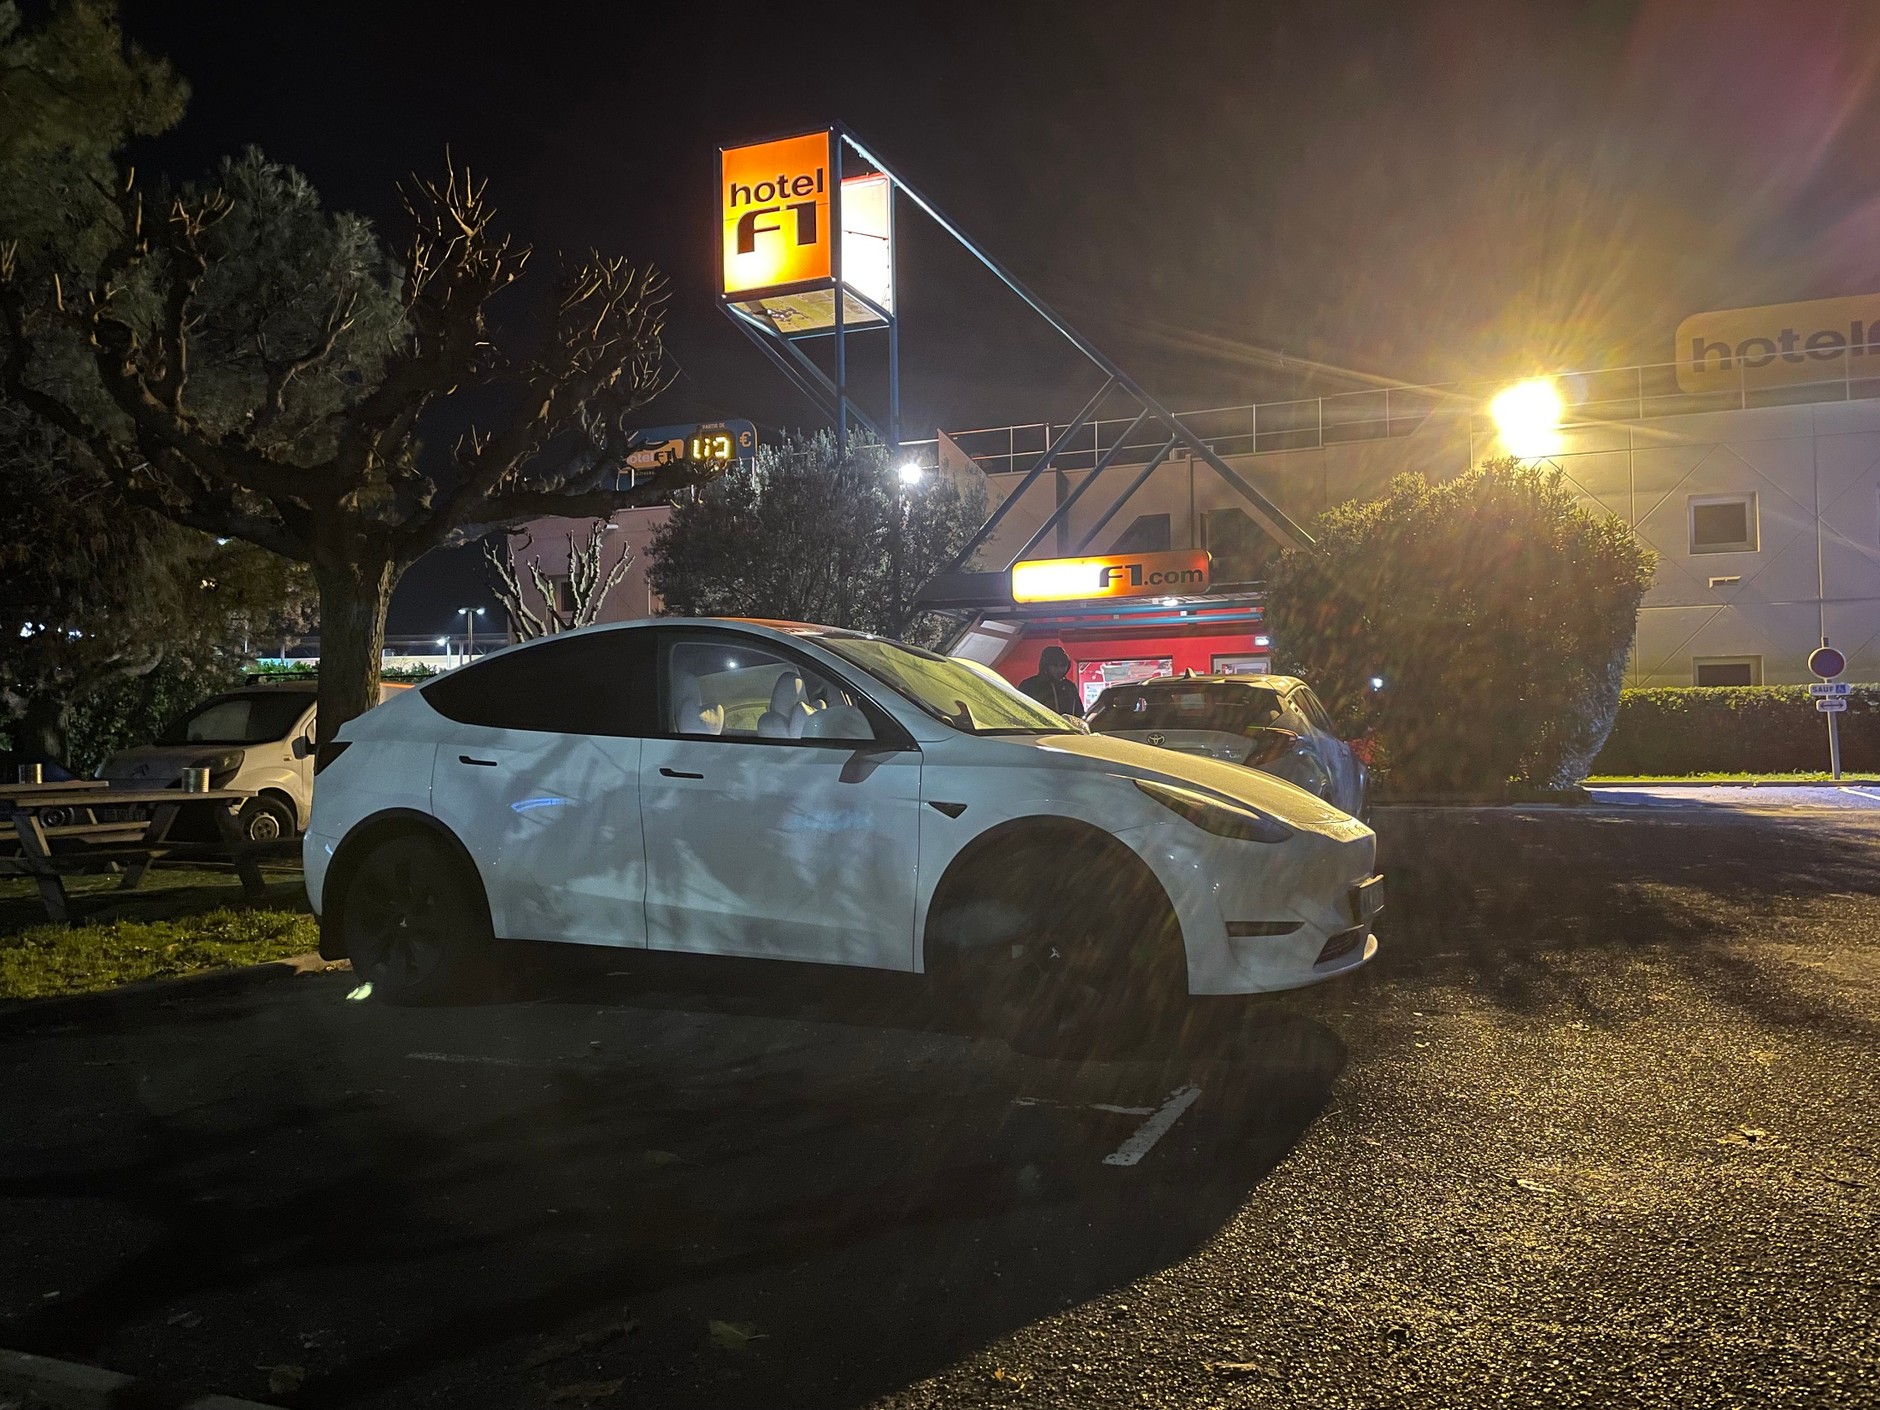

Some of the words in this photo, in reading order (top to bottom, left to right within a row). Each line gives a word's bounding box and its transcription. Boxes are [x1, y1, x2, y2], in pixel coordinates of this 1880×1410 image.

[729, 168, 824, 208] hotel
[737, 200, 817, 255] F1
[739, 430, 752, 448] €
[1812, 686, 1834, 694] SAUF
